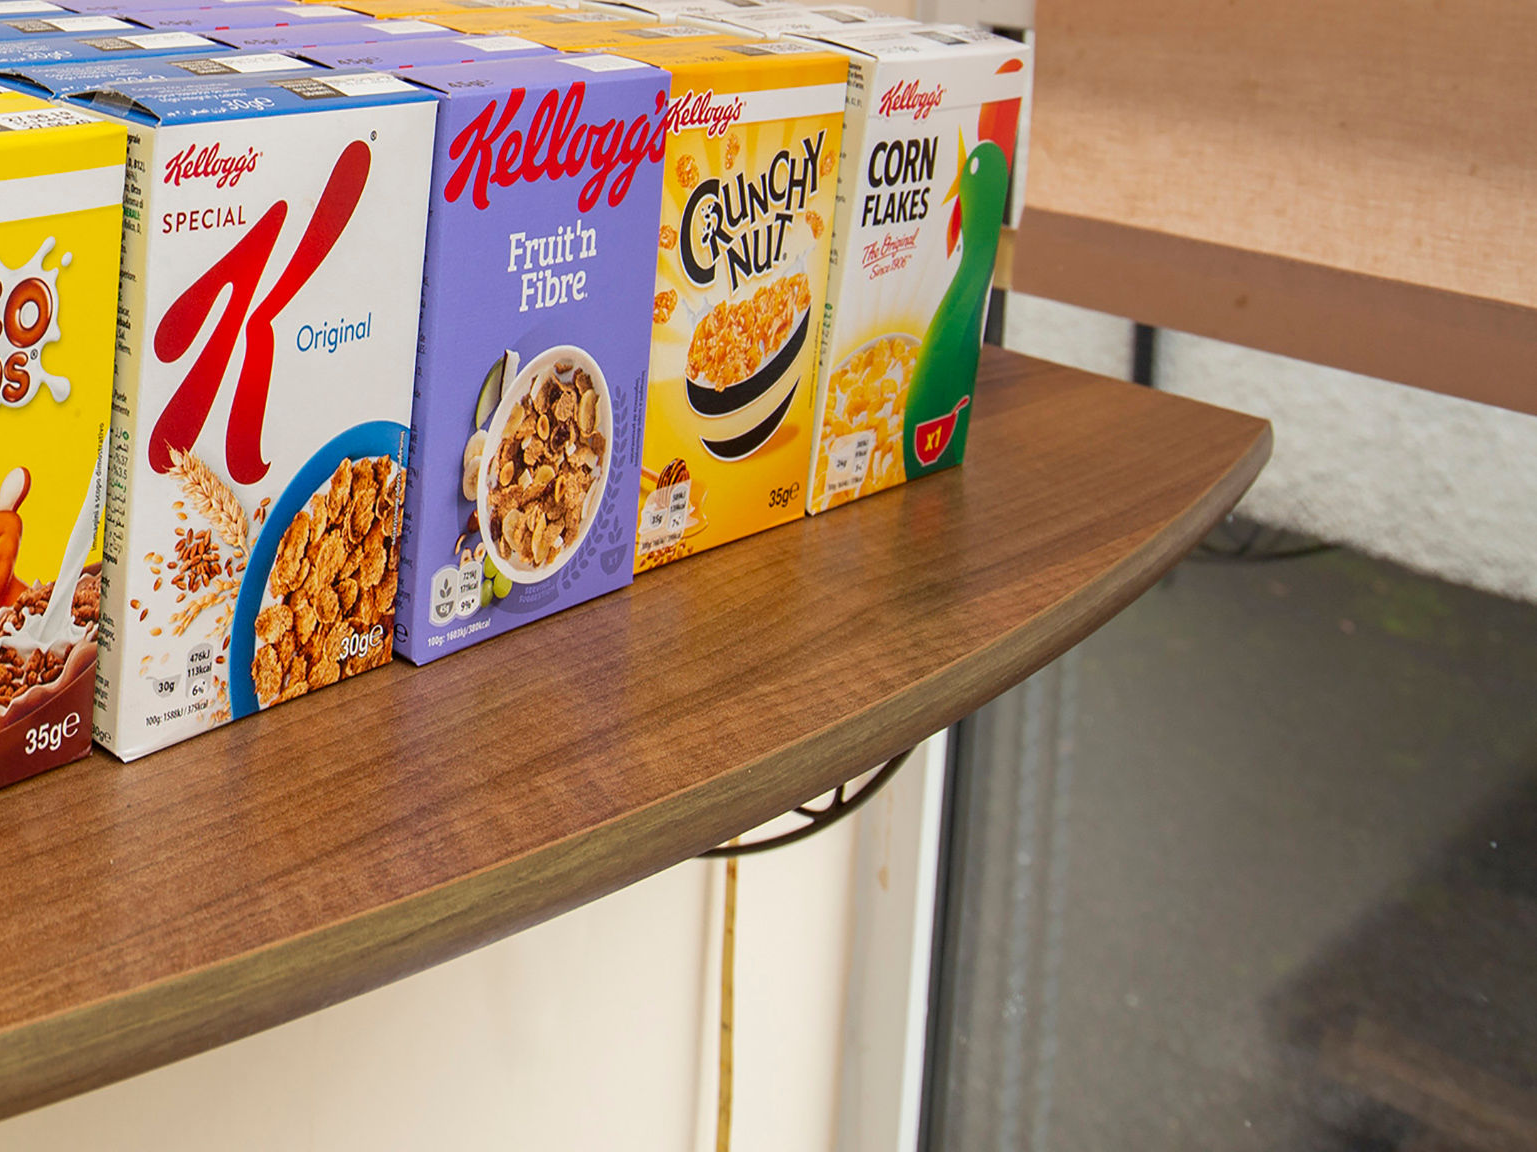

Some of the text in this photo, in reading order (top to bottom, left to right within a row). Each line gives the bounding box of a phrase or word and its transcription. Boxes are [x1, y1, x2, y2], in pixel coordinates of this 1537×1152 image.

[666, 89, 743, 135] Kellogg's
[879, 79, 943, 119] Kellogg's
[163, 142, 260, 189] Kellogg's
[444, 81, 668, 214] Kellogg's
[868, 135, 939, 189] CORN
[162, 204, 247, 234] SPECIAL
[680, 130, 827, 285] CRUNCHY
[861, 186, 931, 229] FLAKES
[726, 212, 793, 293] NUT
[149, 140, 372, 486] K
[519, 269, 588, 313] Fibre
[296, 312, 372, 354] Original
[923, 425, 943, 453] x1
[158, 681, 175, 693] 30g
